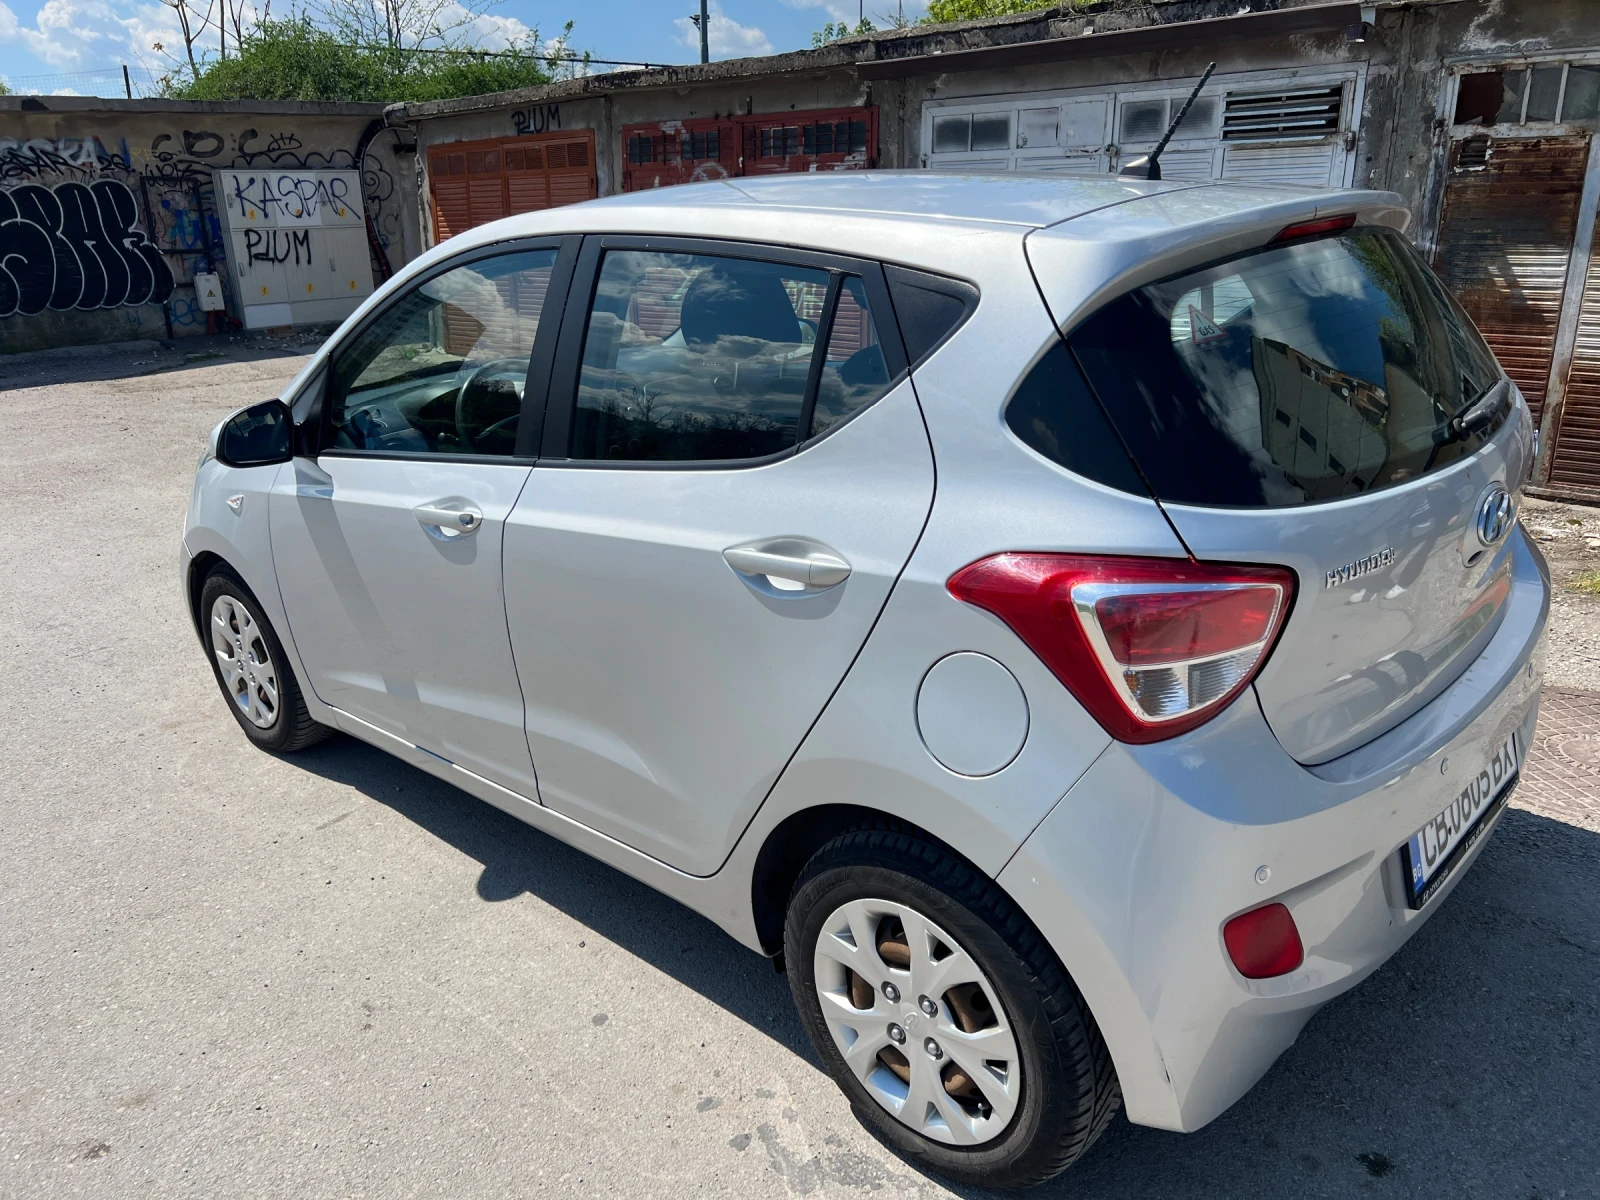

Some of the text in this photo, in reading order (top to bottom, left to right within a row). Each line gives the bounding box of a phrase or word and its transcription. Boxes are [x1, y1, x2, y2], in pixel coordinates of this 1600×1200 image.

[511, 104, 561, 136] PLUM
[232, 175, 362, 220] KASPAR
[244, 228, 313, 268] PLUM
[1198, 324, 1216, 337] GAS
[1325, 547, 1395, 589] HYUNDAI
